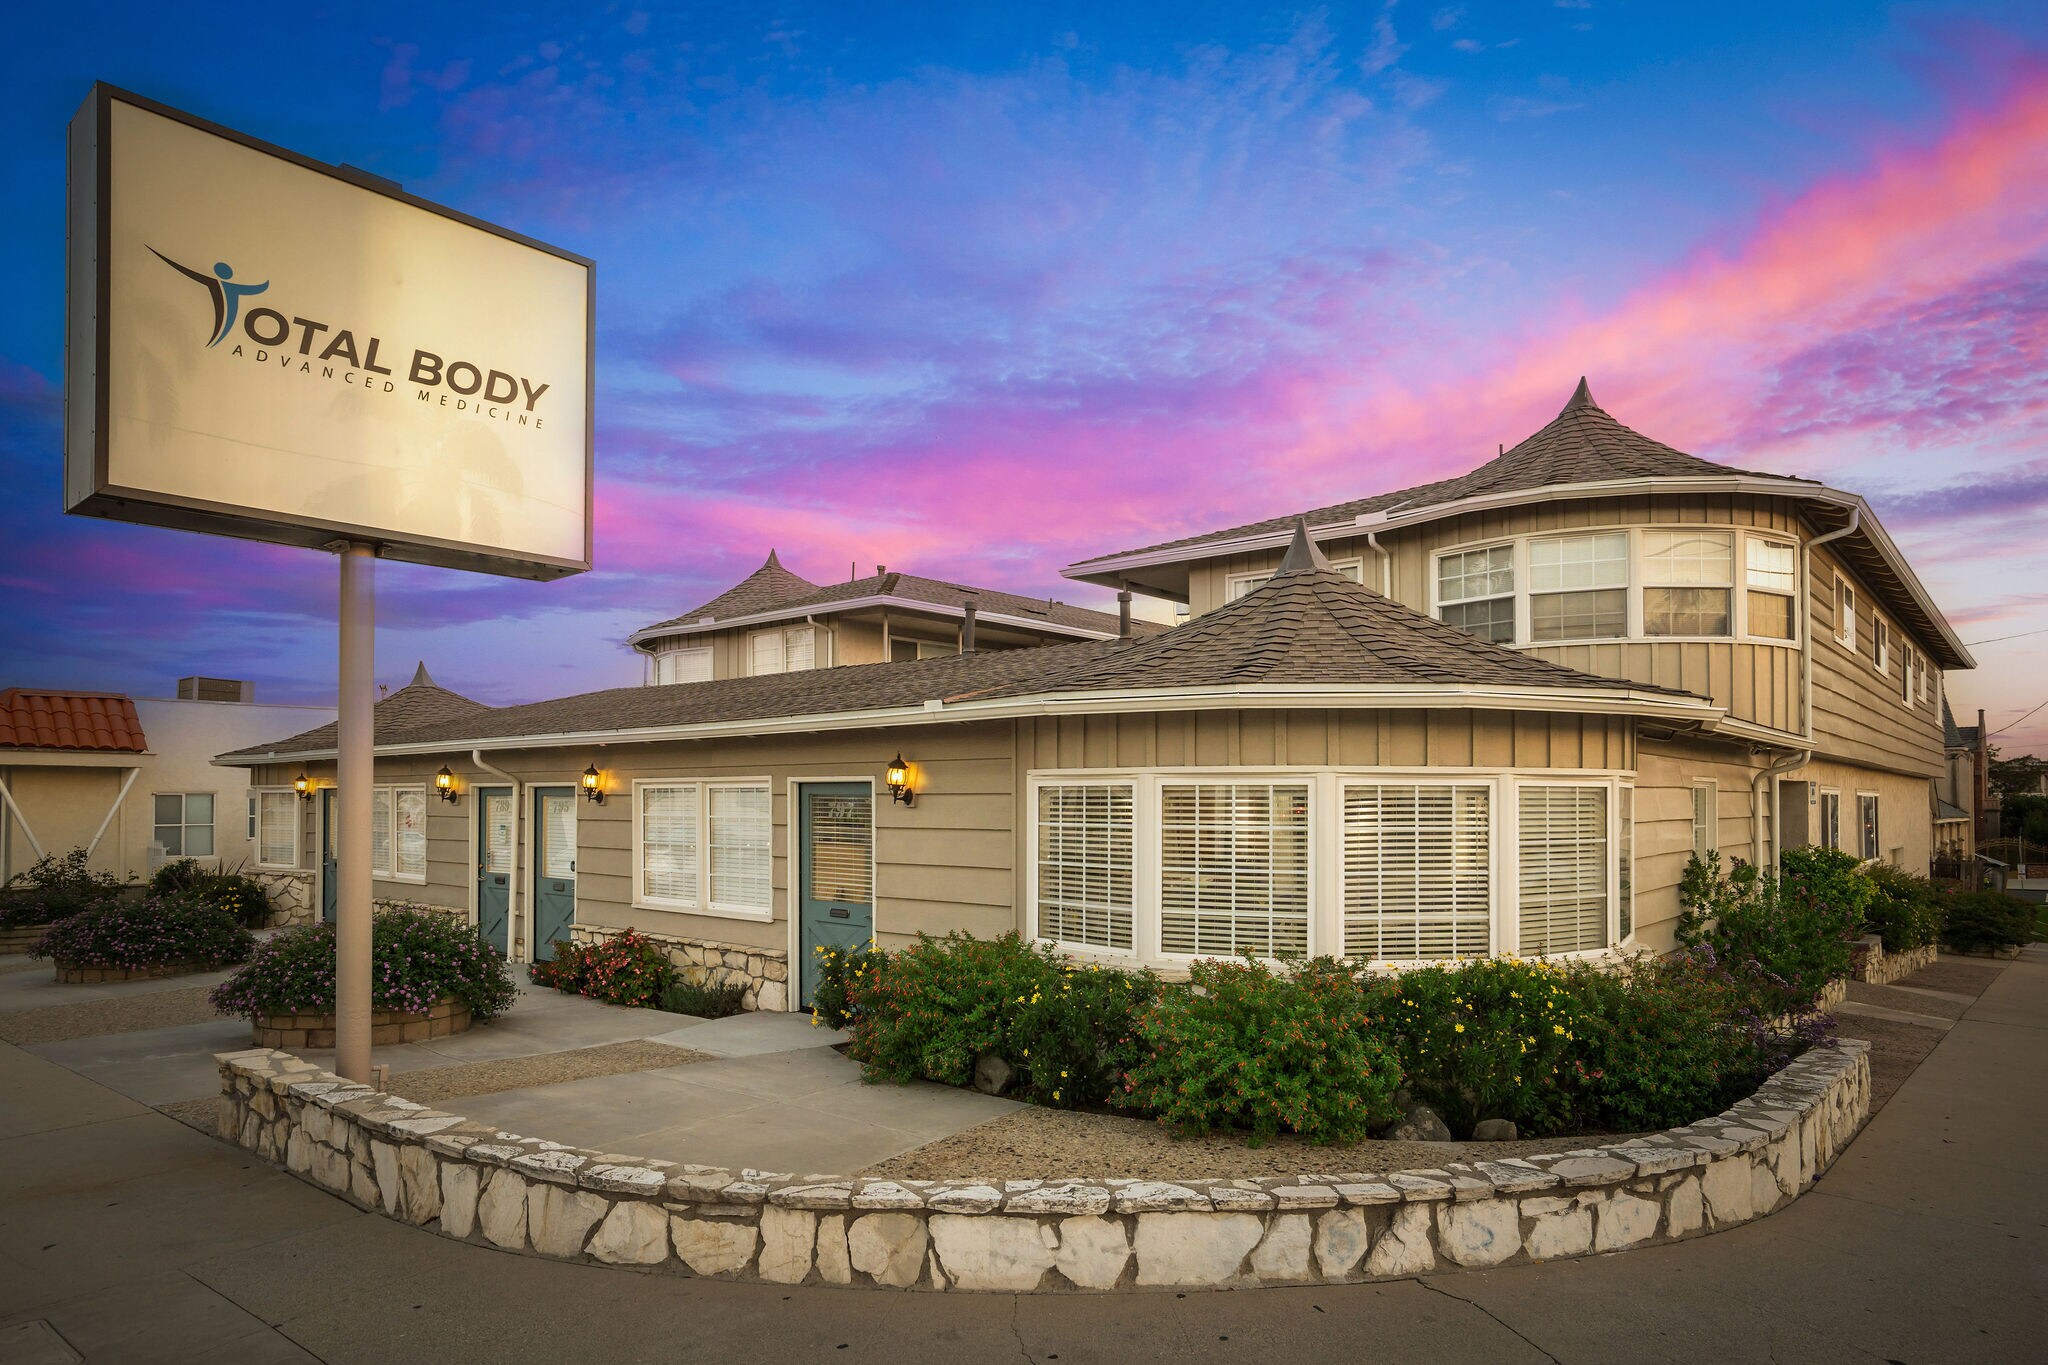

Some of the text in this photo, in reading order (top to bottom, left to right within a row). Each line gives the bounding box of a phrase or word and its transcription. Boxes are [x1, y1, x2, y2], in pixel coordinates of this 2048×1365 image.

[232, 344, 544, 430] ADVANCED MEDICINE
[408, 349, 550, 412] BODY
